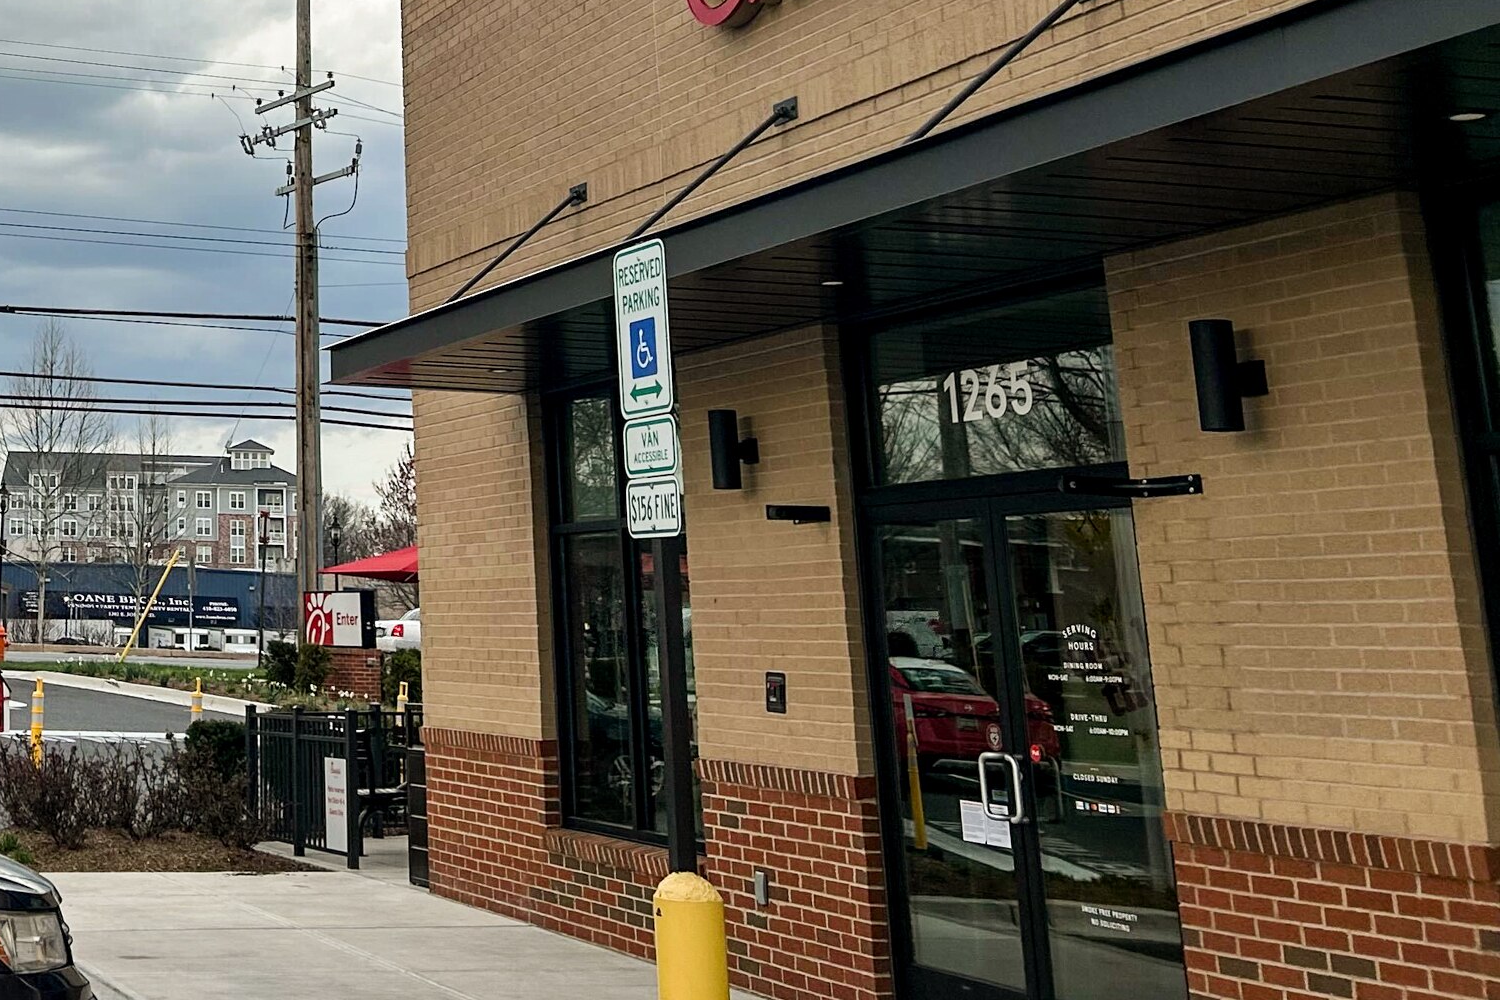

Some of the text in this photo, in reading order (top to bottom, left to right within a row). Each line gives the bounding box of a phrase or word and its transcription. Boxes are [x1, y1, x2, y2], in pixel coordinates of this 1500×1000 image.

[618, 256, 662, 287] RESERVED
[622, 286, 660, 315] PARKING
[943, 360, 1033, 424] 1265
[641, 429, 660, 447] VAN
[633, 448, 669, 462] ACCESSIBLE
[631, 493, 676, 525] $156 FINE
[336, 612, 358, 626] Enter
[1062, 624, 1097, 639] SERVING
[1068, 642, 1094, 651] HOURS
[1085, 662, 1103, 670] ROOM
[1070, 713, 1108, 723] DRIVE-THRU
[1072, 773, 1119, 784] CLOSED SUNDAY
[1090, 918, 1099, 926] NO
[1099, 908, 1111, 918] FREE
[1112, 910, 1138, 922] PROPERTY
